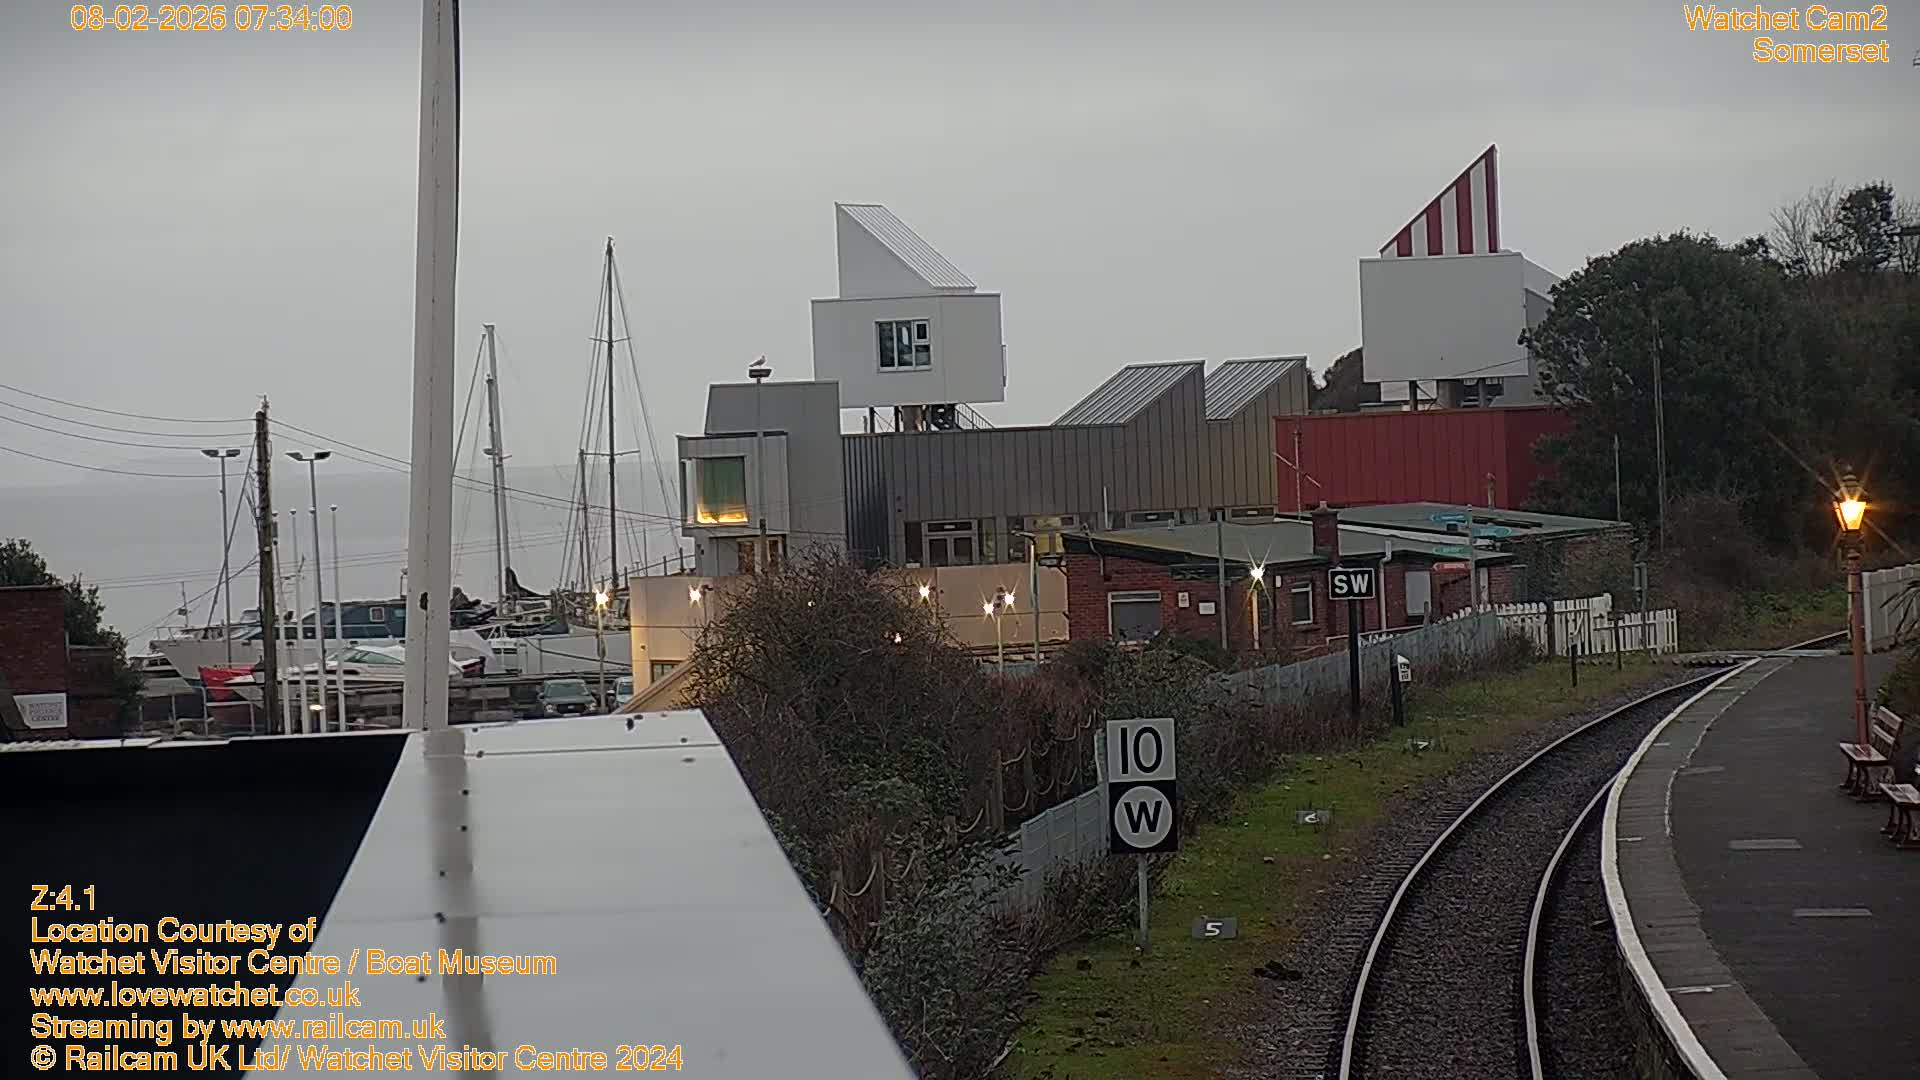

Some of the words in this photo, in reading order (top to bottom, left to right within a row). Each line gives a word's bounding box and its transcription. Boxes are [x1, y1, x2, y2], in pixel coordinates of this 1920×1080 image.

[1333, 573, 1369, 594] SW
[1120, 726, 1163, 775] 10
[1123, 800, 1163, 834] W
[1204, 922, 1224, 937] 5
